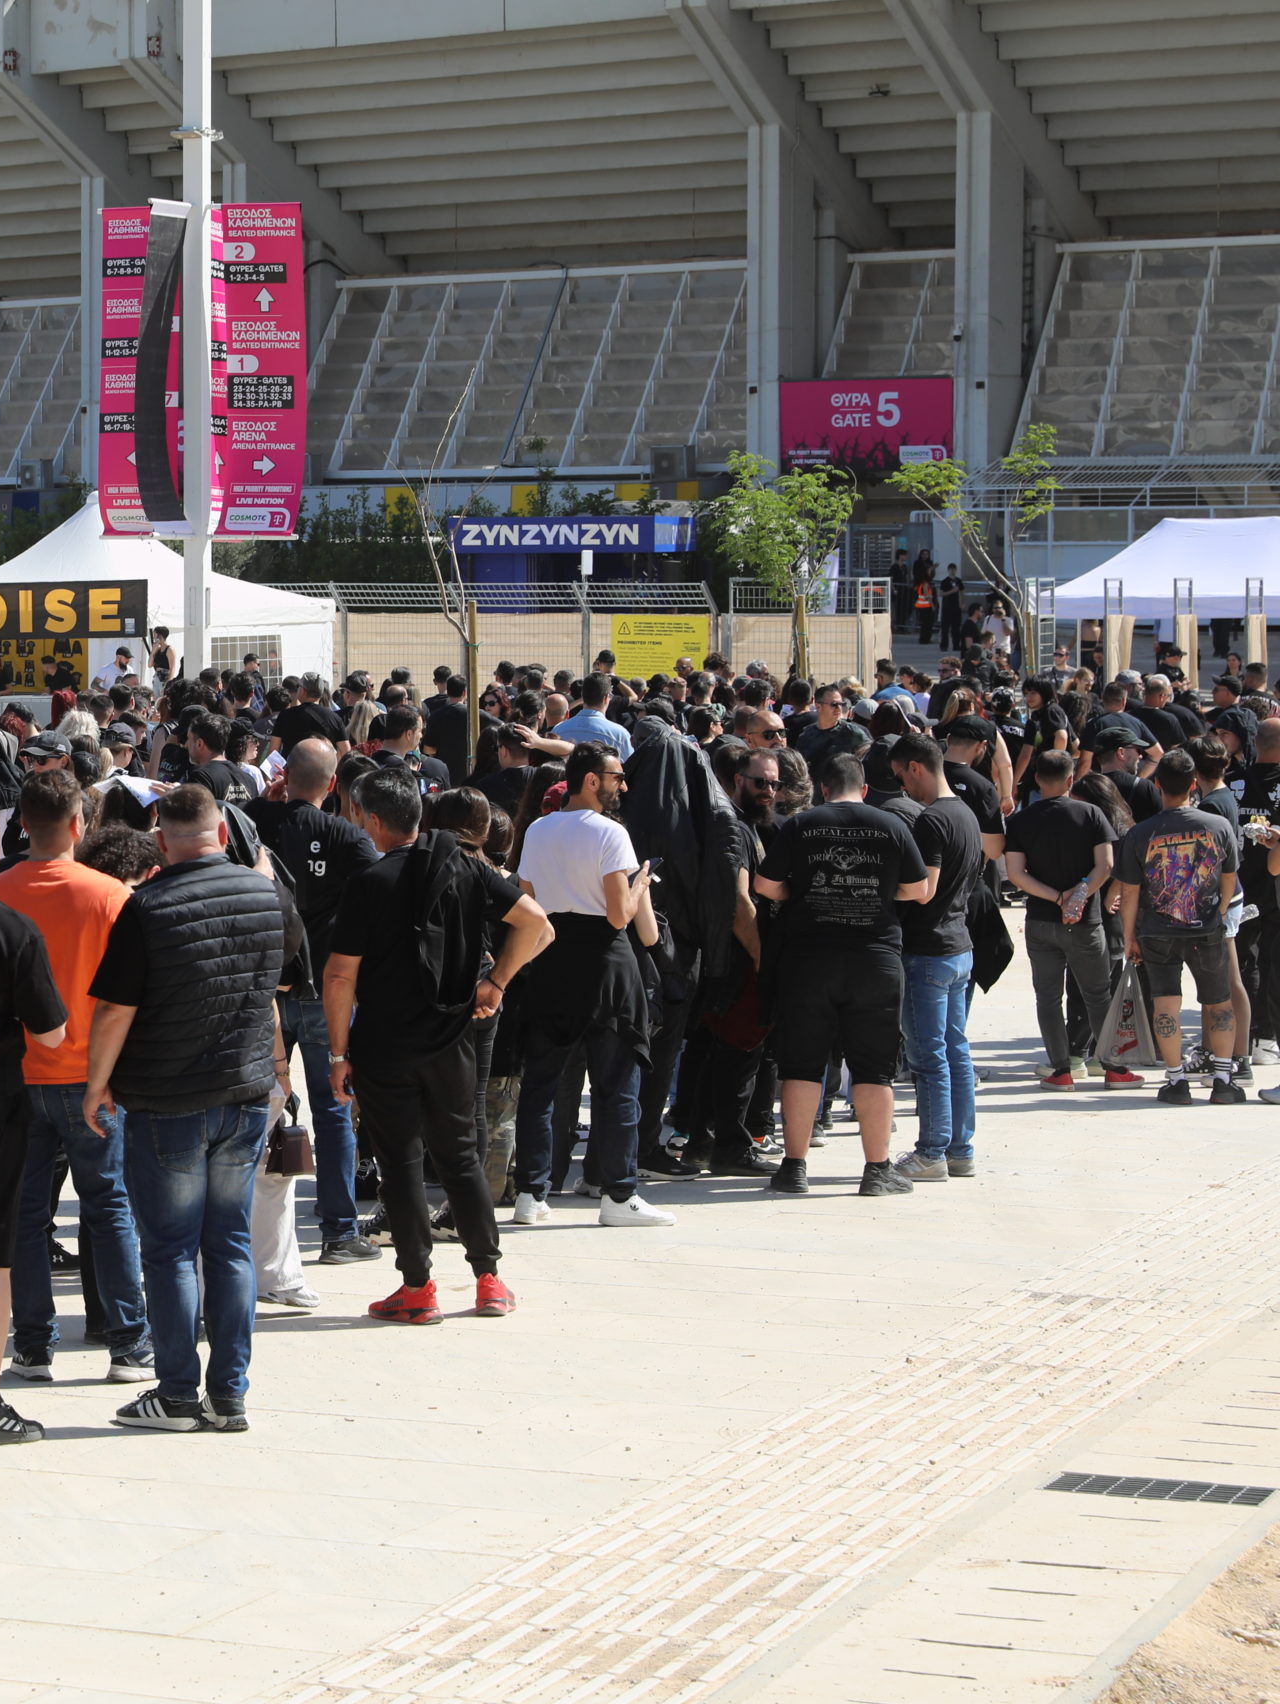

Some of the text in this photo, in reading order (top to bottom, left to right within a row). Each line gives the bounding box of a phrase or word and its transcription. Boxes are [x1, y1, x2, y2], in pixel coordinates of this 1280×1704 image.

[227, 209, 272, 217] ΕΙΣΟΔΟΣ
[228, 218, 296, 228] ΚΑΘΗΜΕΝΩΝ
[108, 226, 150, 234] ΚΑΘΗΜΕΝ
[234, 245, 244, 259] 2
[106, 267, 142, 276] 6-7-8-9-10
[106, 298, 139, 306] ΕΙΣΟΔΟΣ
[232, 322, 276, 330] ΕΙΣΟΔΟΣ
[232, 332, 300, 340] ΚΑΘΗΜΕΝΩΝ
[105, 340, 128, 348] ΘΥΡΕΣ
[238, 357, 244, 372] 1
[831, 393, 871, 406] ΘΥΡΑ
[876, 392, 901, 427] 5
[831, 414, 871, 427] GATE
[232, 422, 277, 430] ΕΙΣΟΔΟΣ
[232, 432, 266, 440] ARENA
[802, 828, 888, 838] METAL GATES
